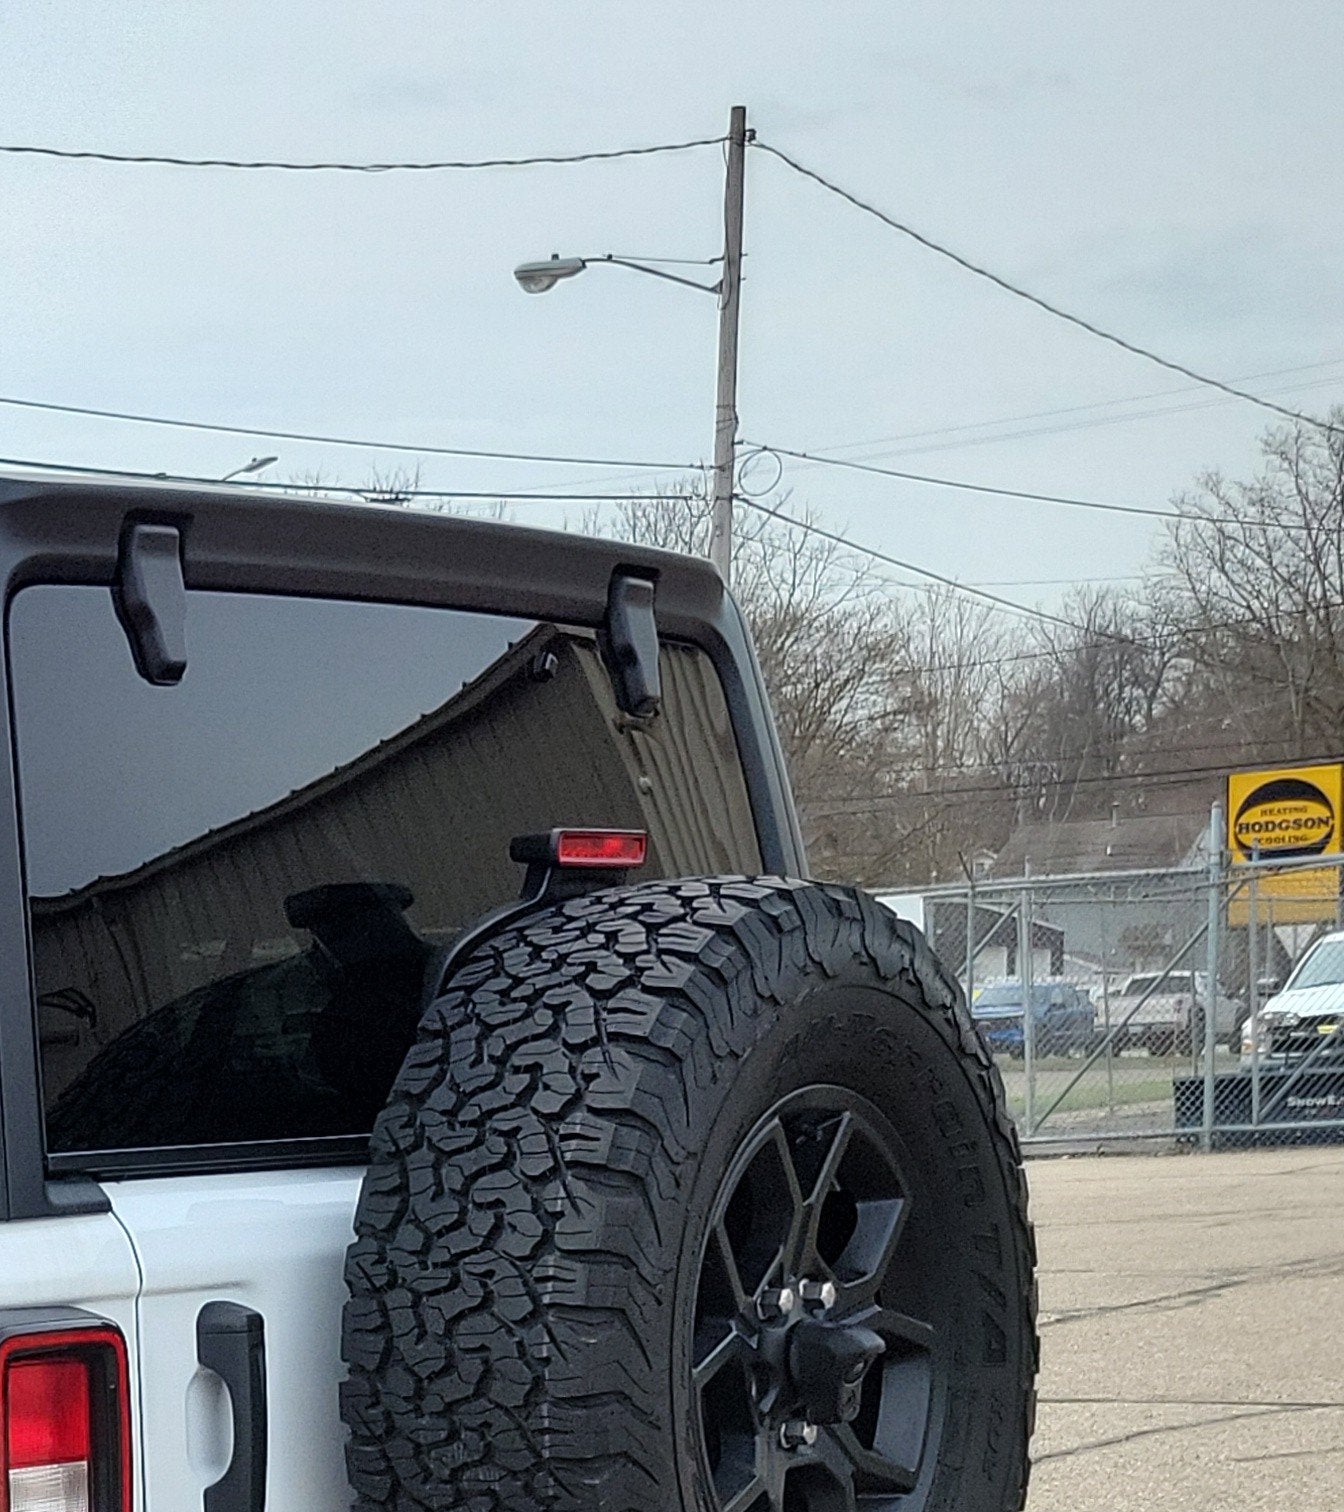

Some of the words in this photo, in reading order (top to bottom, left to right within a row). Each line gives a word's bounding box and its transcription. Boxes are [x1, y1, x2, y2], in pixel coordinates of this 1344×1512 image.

[1260, 805, 1308, 817] HEATING
[1237, 815, 1332, 835] HODGSON
[1256, 834, 1309, 846] COOLING
